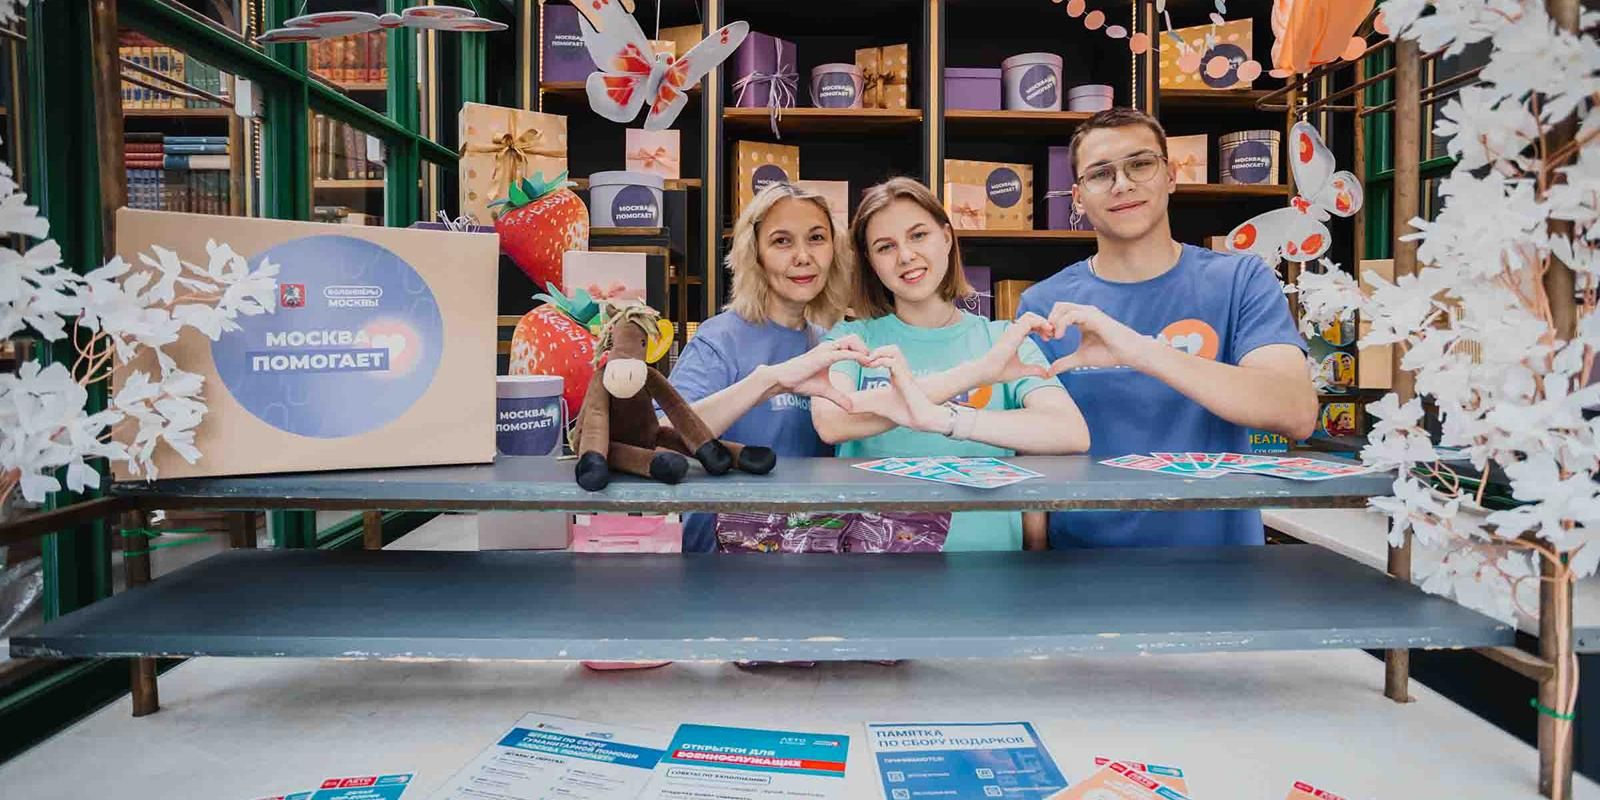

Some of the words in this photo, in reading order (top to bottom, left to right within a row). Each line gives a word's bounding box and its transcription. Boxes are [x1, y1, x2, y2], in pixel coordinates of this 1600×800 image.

[616, 212, 652, 220] ПОМОГАЕТ
[328, 299, 379, 307] МОСКВЫ
[266, 330, 371, 347] МОСКВА
[253, 353, 384, 371] ПОМОГАЕТ
[500, 408, 546, 420] МОСКВА
[496, 419, 552, 432] ПОМОГАЕТ
[876, 730, 943, 738] ПАМЯТКА
[902, 738, 946, 747] СБОРУ
[950, 736, 1025, 746] ПОДАРКОВ
[682, 743, 747, 754] ОТКРЫТКИ
[749, 749, 776, 757] ДЛЯ
[677, 751, 803, 767] ВОЕННОСЛУЖАЩИХ
